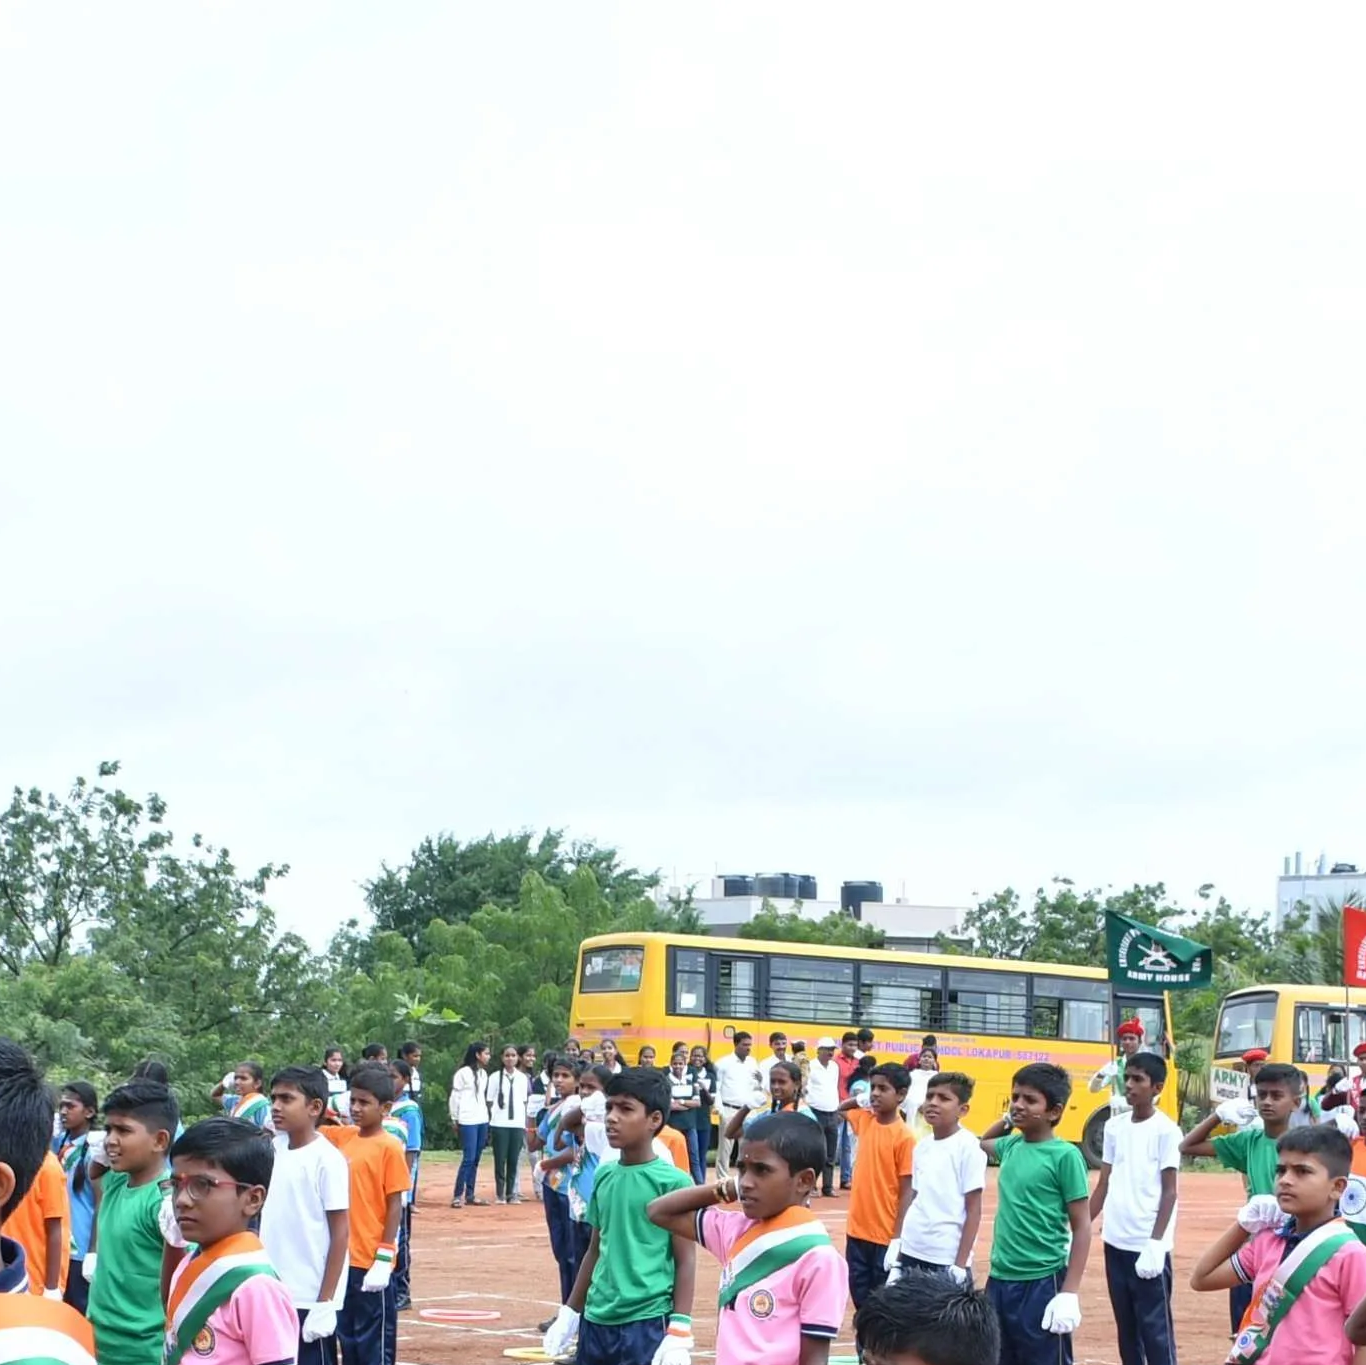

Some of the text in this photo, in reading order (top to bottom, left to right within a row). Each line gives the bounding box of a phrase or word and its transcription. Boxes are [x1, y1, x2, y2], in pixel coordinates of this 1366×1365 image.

[1127, 970, 1191, 982] ARMY HOUSE
[966, 1048, 1012, 1060] LOKAPUR
[1214, 1069, 1246, 1088] ARMY
